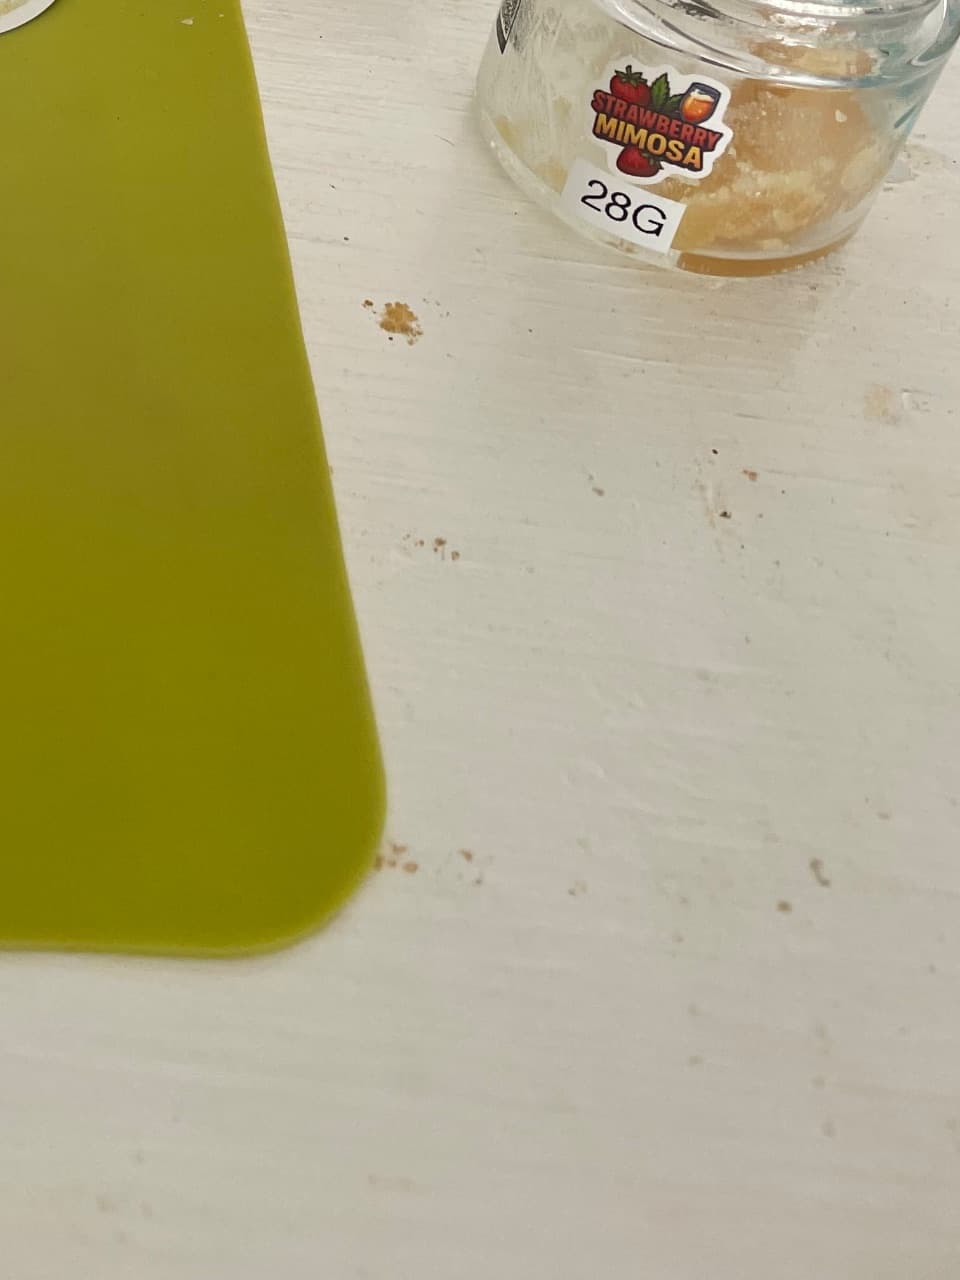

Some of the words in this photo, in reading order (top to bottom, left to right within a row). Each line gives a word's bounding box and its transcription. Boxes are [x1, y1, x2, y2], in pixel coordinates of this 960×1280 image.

[592, 90, 721, 149] STRAWBERRY
[595, 113, 702, 169] MIMOSA
[580, 179, 667, 237] 28G
